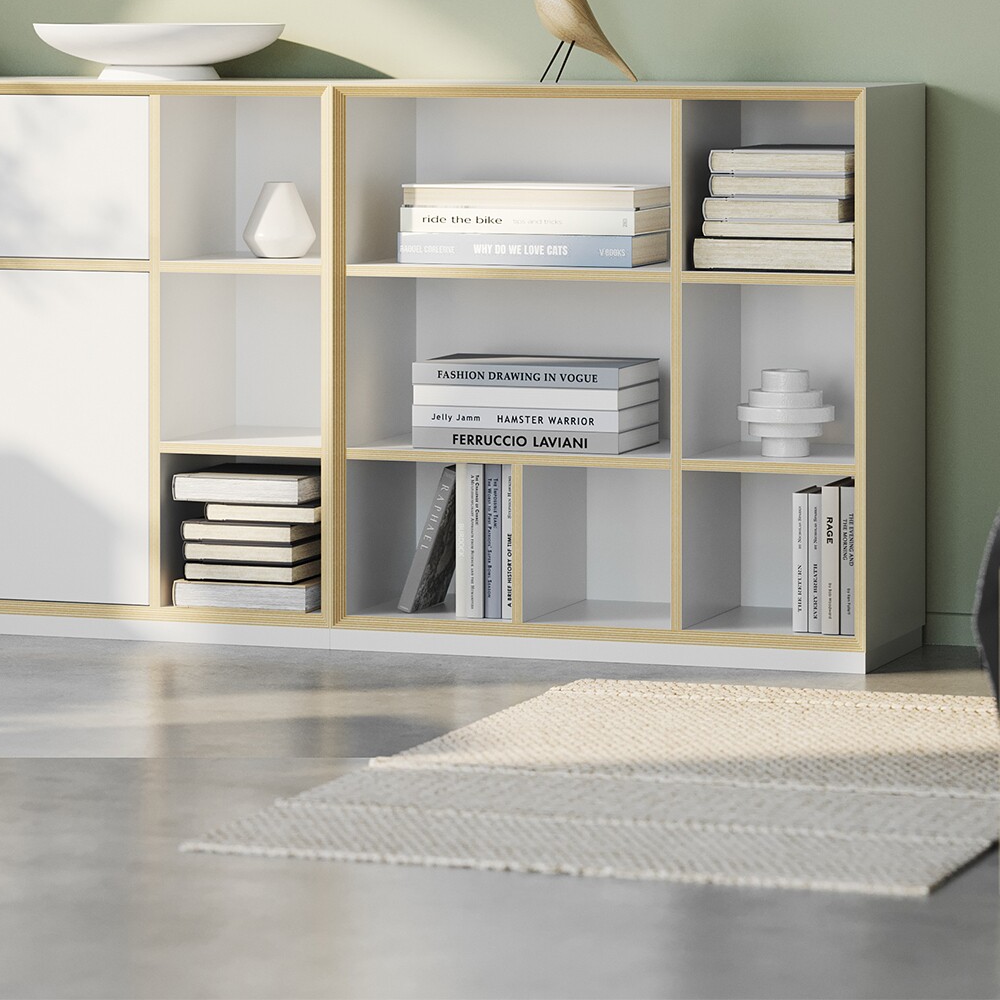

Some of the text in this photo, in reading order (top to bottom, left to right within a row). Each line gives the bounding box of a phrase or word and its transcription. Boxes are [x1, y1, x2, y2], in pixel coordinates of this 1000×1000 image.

[422, 214, 448, 225] ride
[451, 214, 472, 225] the
[475, 214, 504, 226] bike
[473, 244, 493, 256] WHY
[494, 244, 508, 256] DO
[508, 244, 522, 256] WE
[524, 244, 545, 256] LOVE
[546, 244, 568, 256] CATS
[437, 370, 598, 384] FASHION DRAWING IN VOGUE
[431, 412, 595, 427] Jelly Jamm HAMSTER WARRIOR
[452, 434, 588, 449] FERRUCCIO LAVIANI
[420, 482, 450, 550] RAPHAEL
